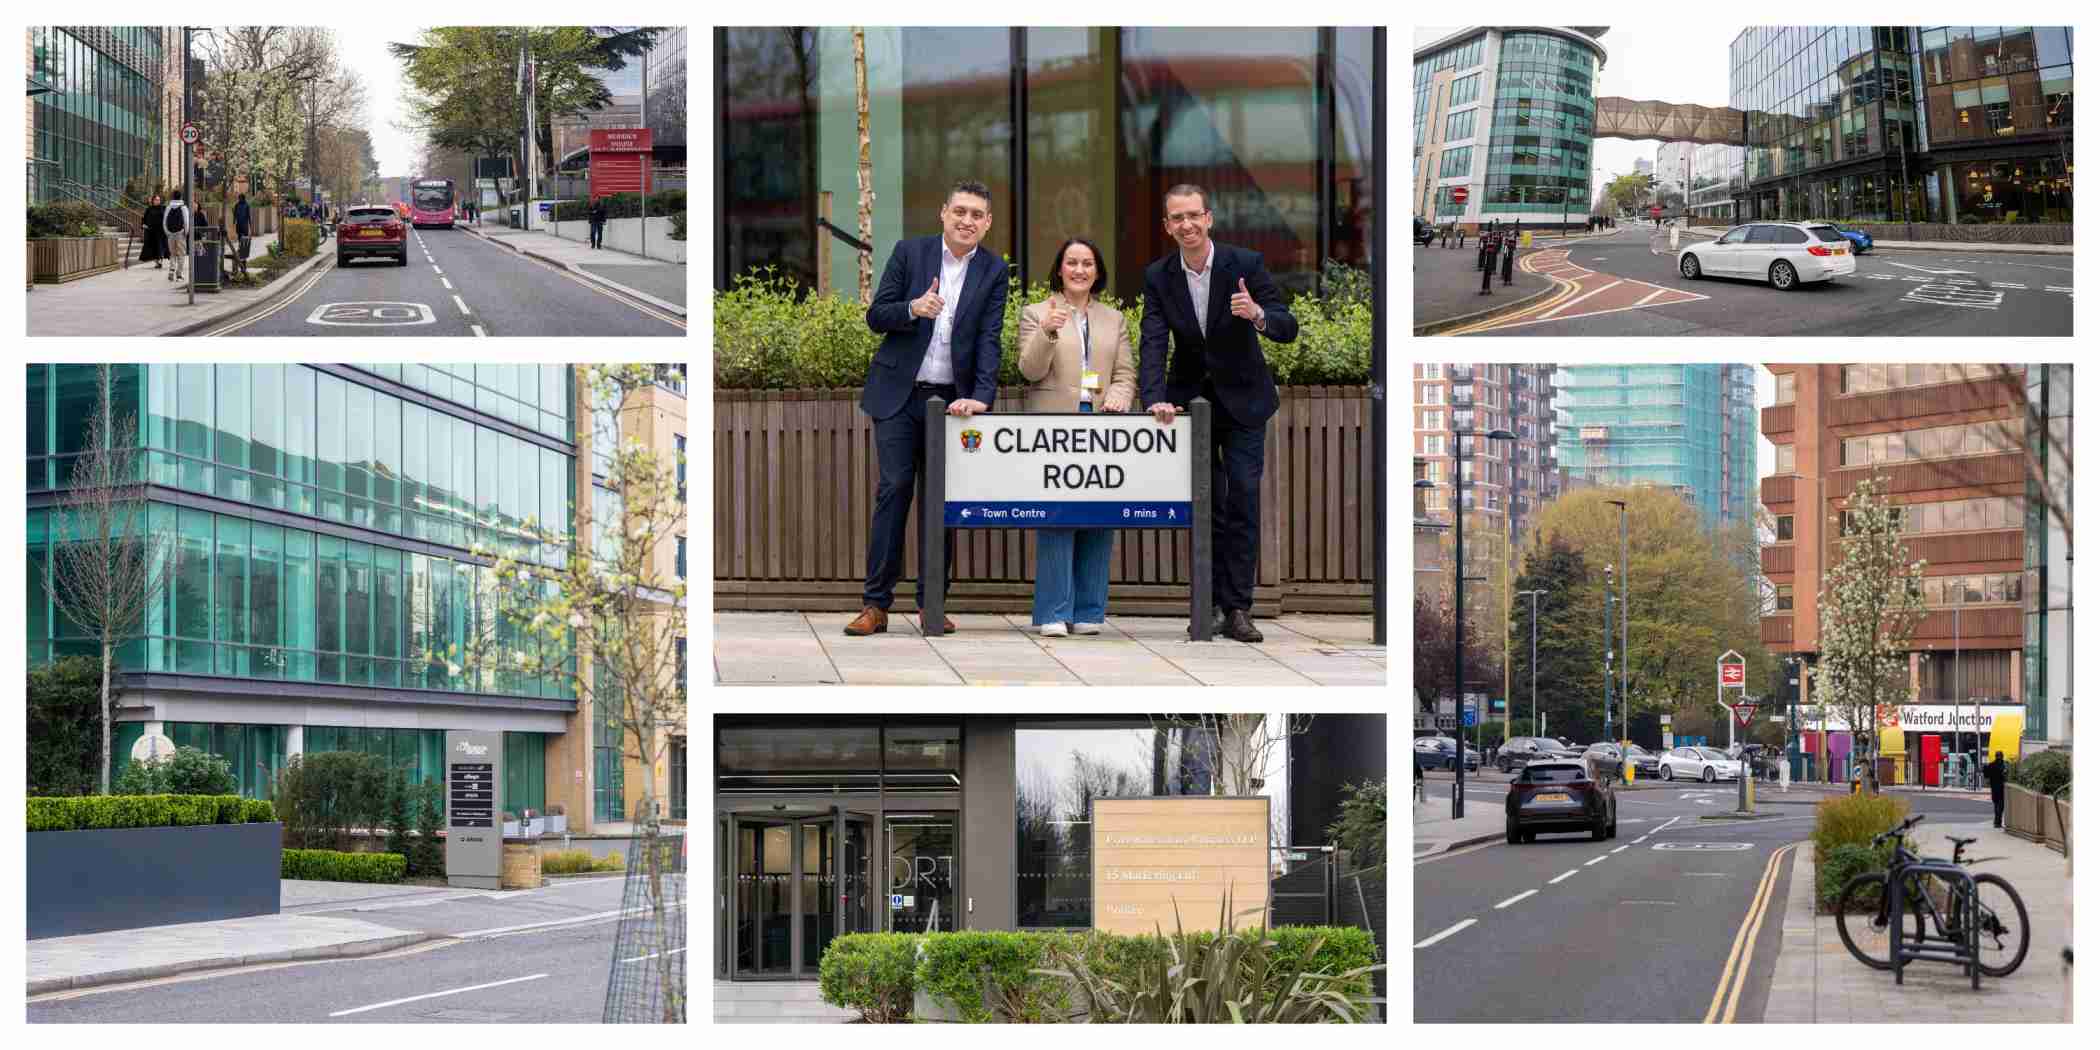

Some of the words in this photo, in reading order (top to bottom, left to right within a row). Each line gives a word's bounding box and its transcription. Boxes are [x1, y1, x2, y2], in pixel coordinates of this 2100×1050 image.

[183, 129, 197, 138] 20
[323, 307, 418, 320] 20
[993, 427, 1177, 453] CLARENDON
[1043, 464, 1125, 489] ROAD
[982, 508, 1008, 518] Town
[1011, 508, 1046, 518] Centre
[1122, 508, 1131, 518] 8
[1134, 507, 1157, 518] mins
[1903, 711, 1944, 725] Watford
[1948, 711, 1992, 726] Juncton
